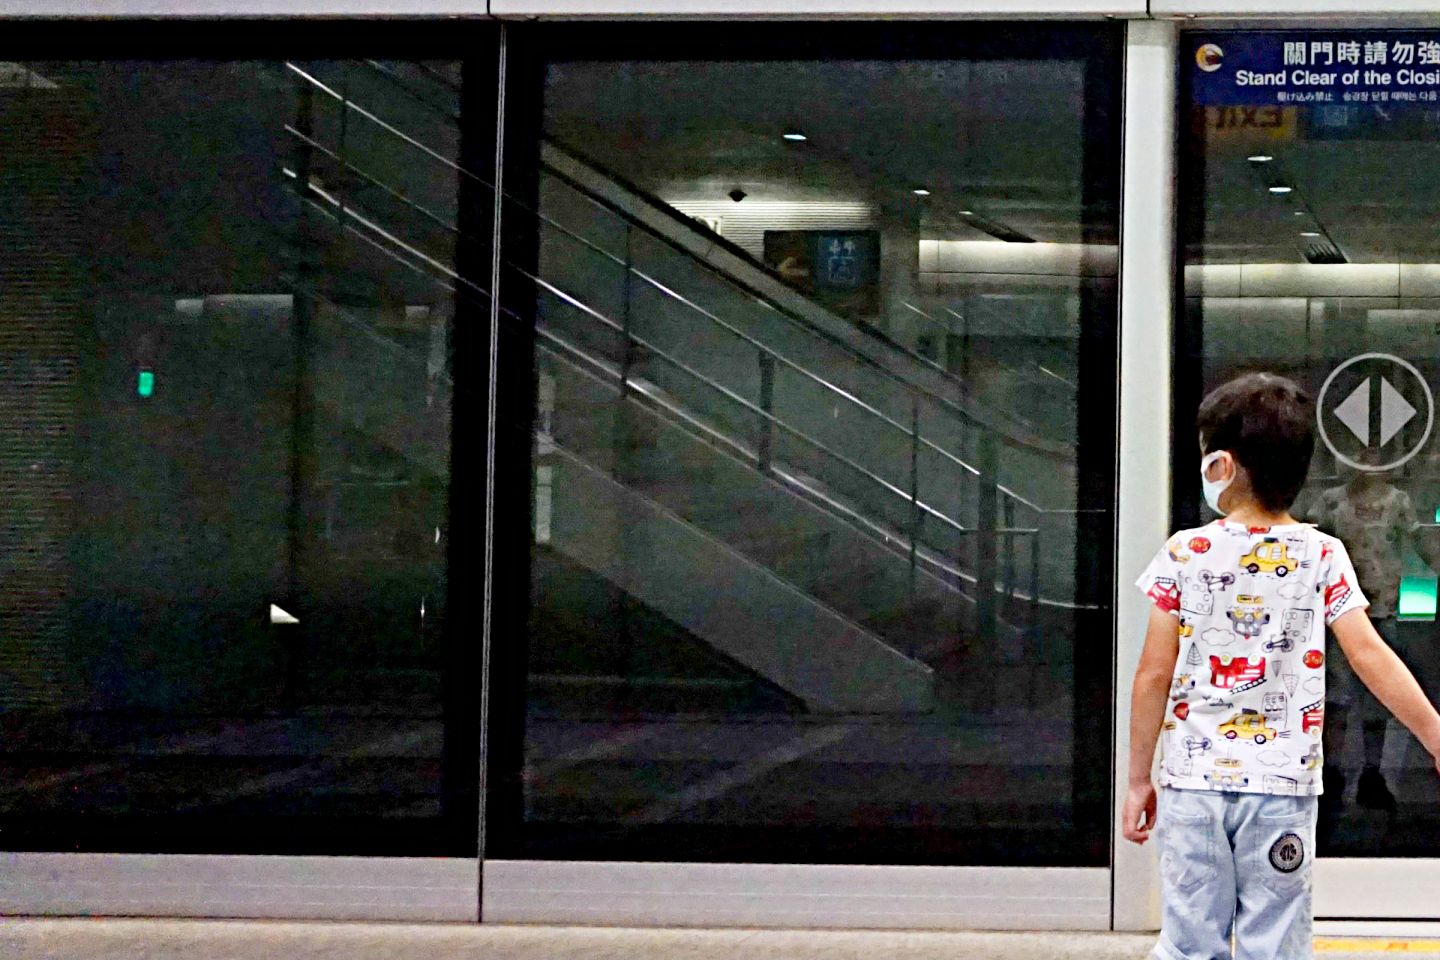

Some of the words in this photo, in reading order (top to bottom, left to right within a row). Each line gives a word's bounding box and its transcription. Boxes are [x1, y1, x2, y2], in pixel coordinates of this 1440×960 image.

[1235, 68, 1287, 86] Stand
[1291, 68, 1338, 86] Clear
[1341, 68, 1361, 86] of
[1363, 68, 1392, 86] the
